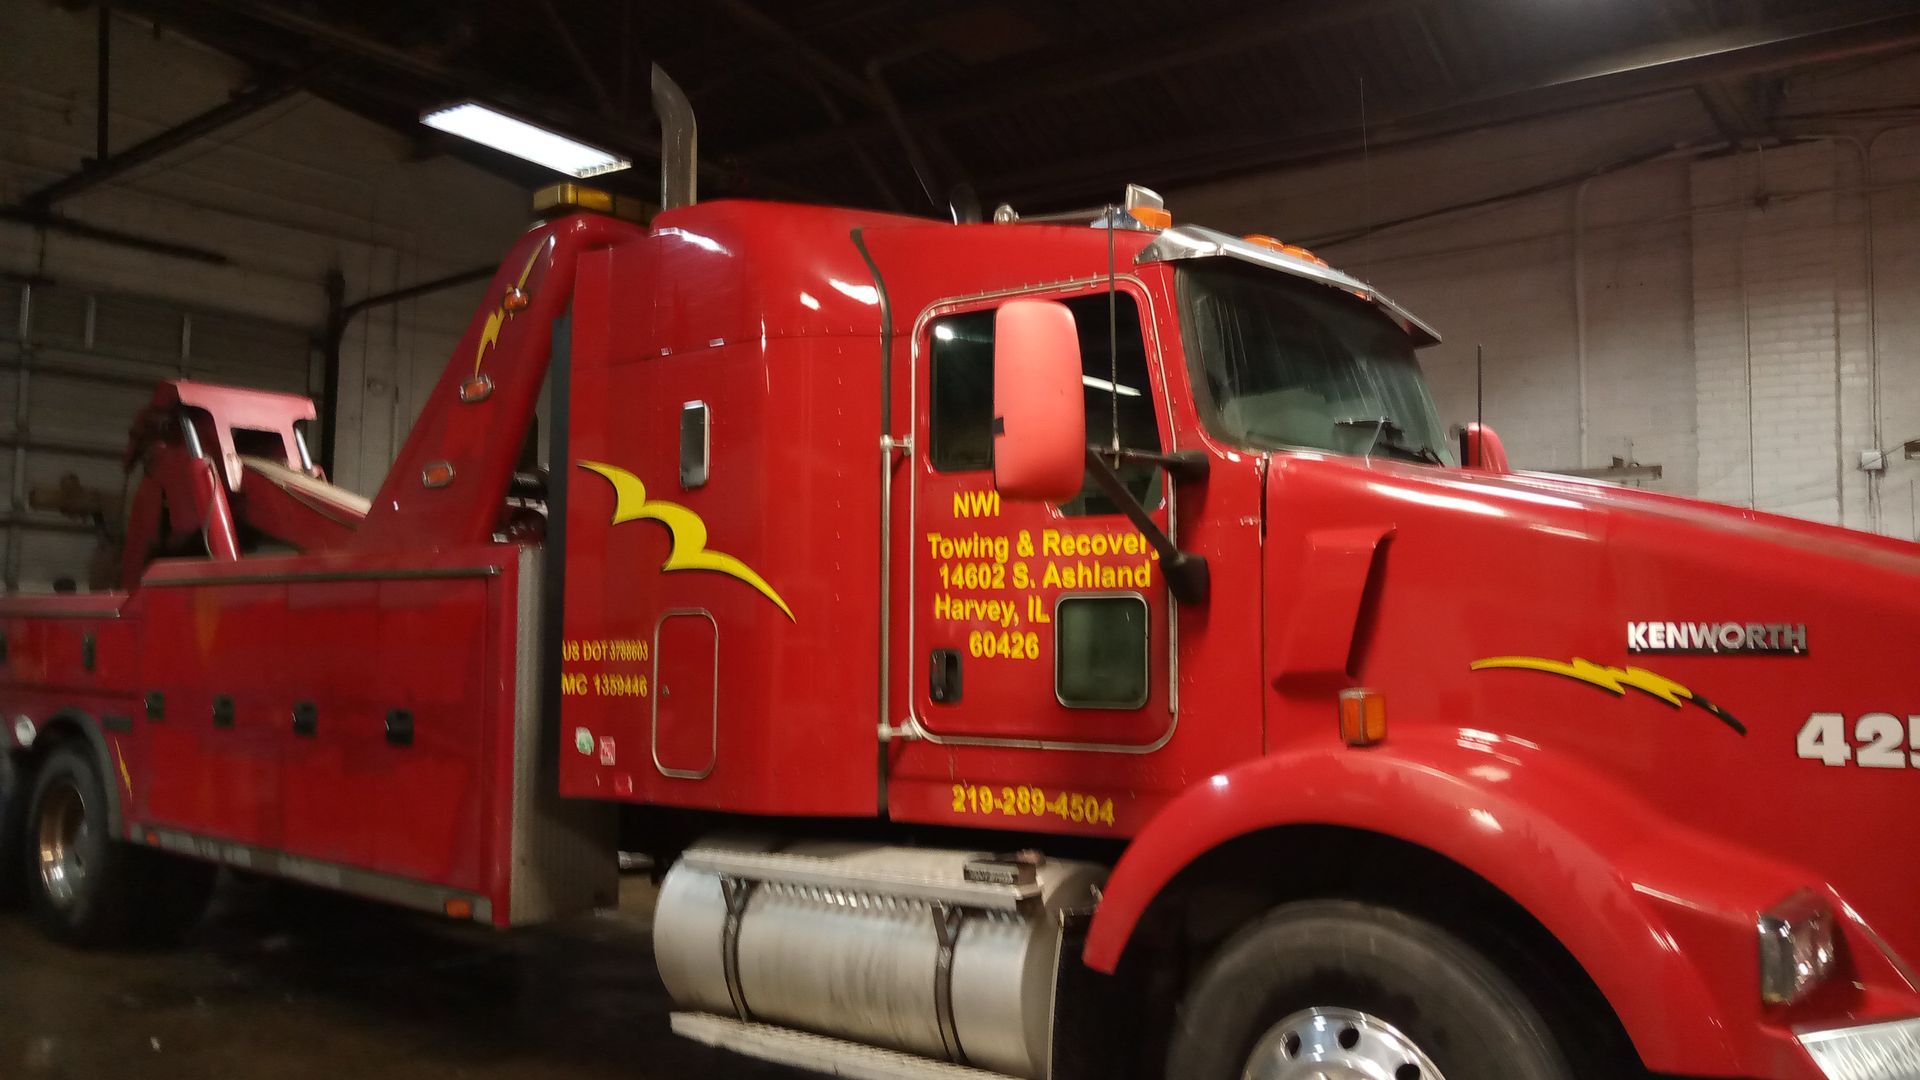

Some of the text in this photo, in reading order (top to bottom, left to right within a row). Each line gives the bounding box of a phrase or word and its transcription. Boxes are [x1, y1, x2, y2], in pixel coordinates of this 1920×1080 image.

[953, 490, 1001, 519] NWI
[927, 529, 1160, 563] Towing & Recover
[940, 559, 1151, 590] 14602 S. Ashland
[935, 592, 1051, 628] Harvey, IL
[562, 640, 580, 661] US
[582, 640, 608, 661] DOT
[969, 630, 1040, 660] 60426
[1627, 621, 1808, 650] KENWORTH
[561, 672, 588, 696] MC
[1796, 712, 1920, 769] 42
[952, 784, 1115, 827] 219-289-4504
